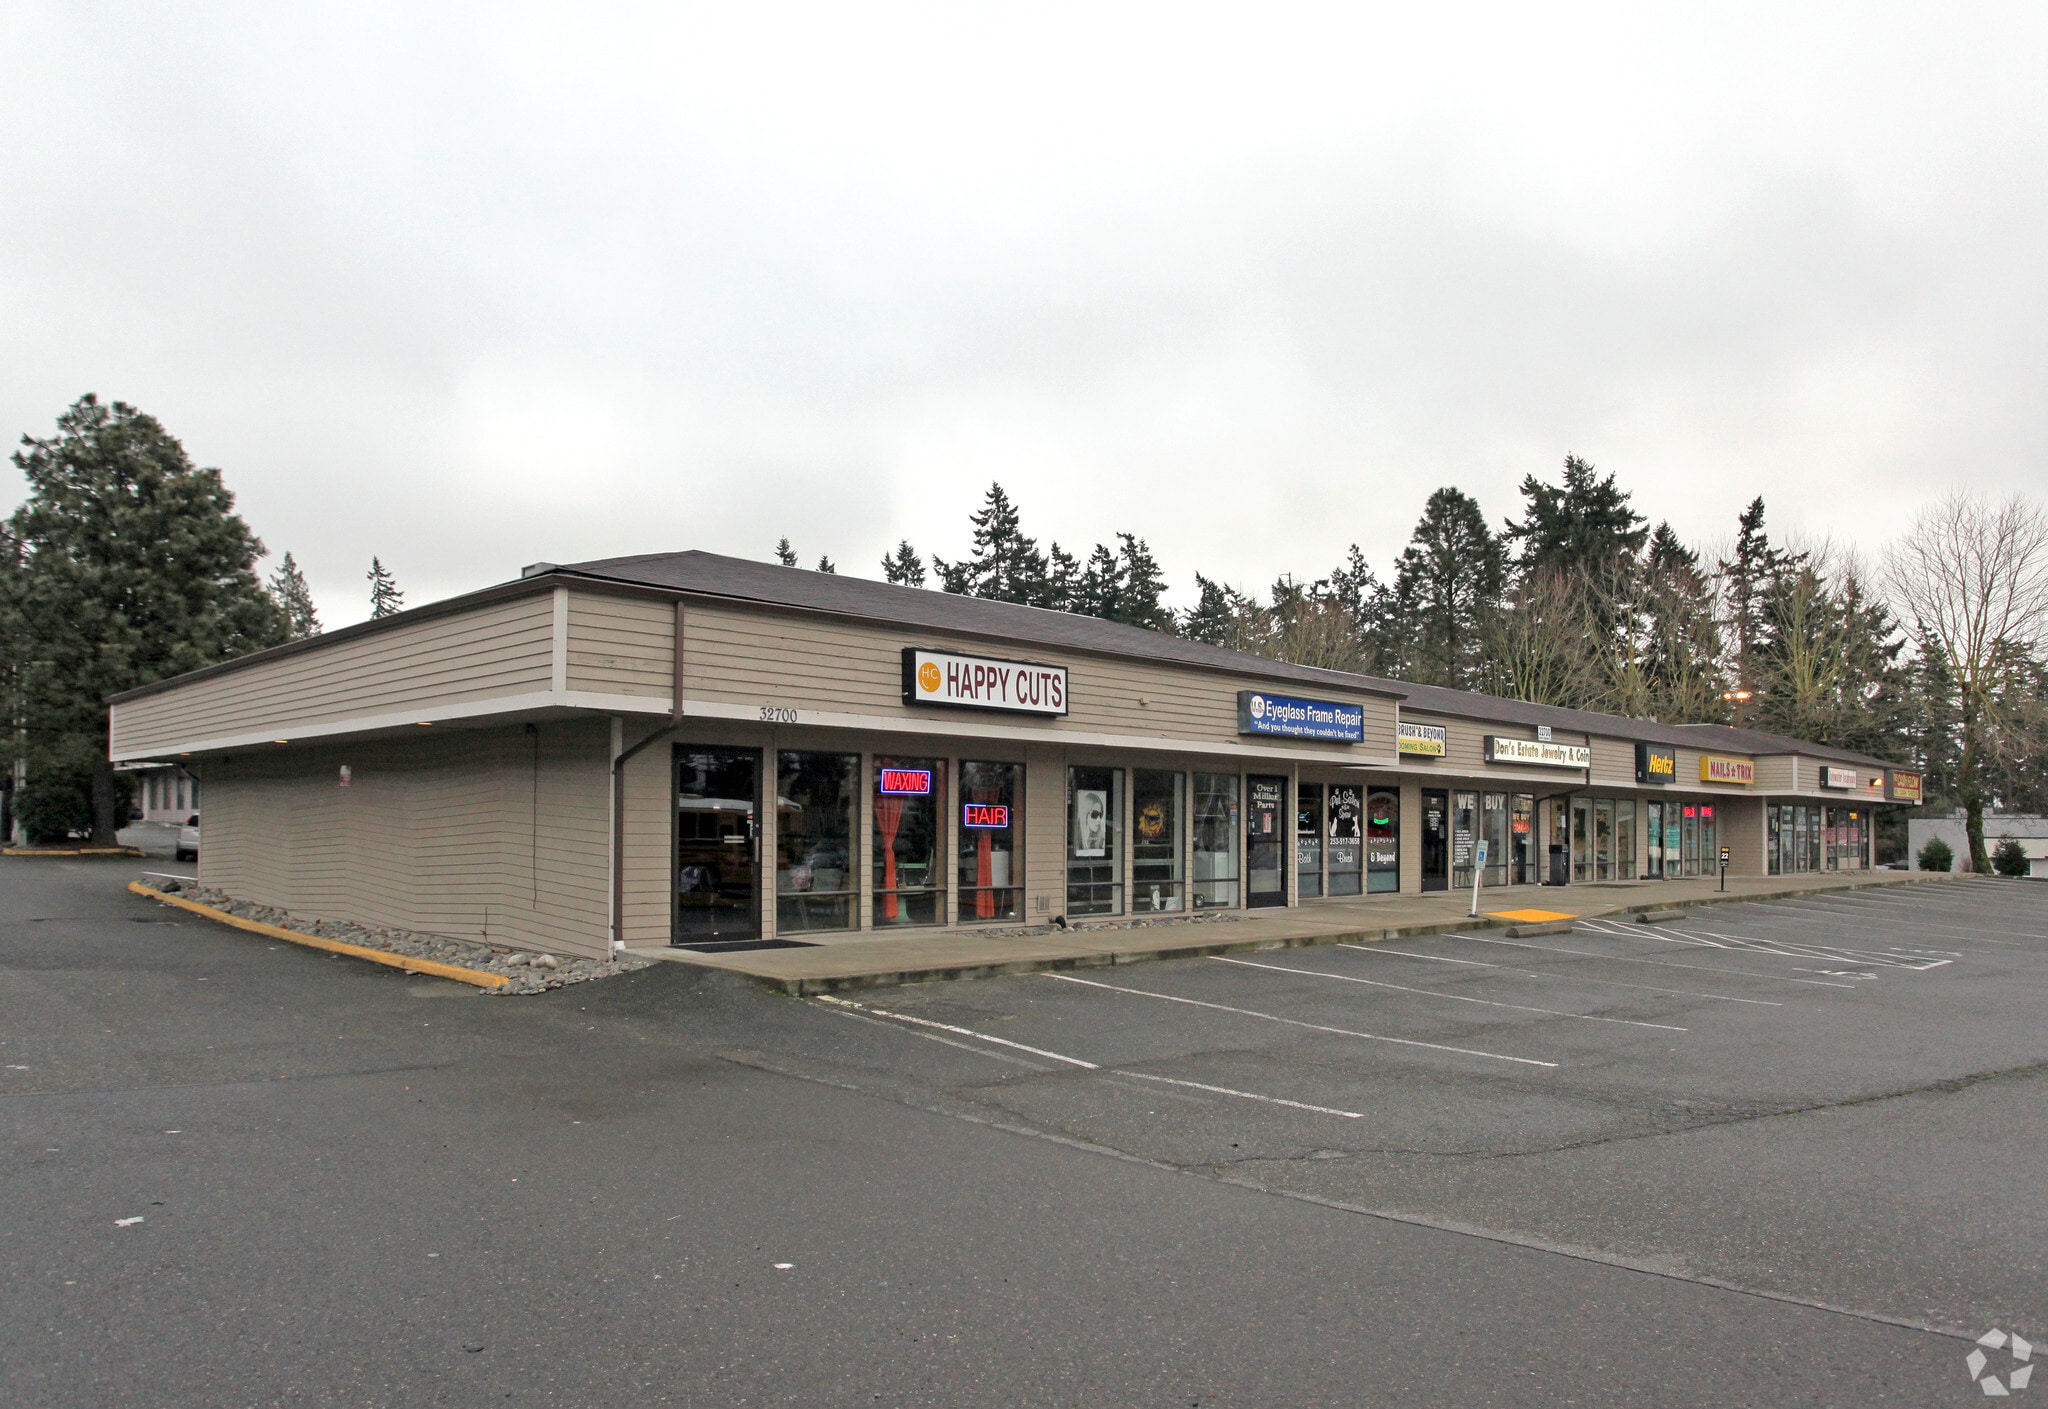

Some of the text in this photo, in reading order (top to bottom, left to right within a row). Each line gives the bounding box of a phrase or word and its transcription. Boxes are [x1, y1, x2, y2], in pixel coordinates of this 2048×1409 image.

[922, 667, 938, 680] HC
[947, 661, 1062, 708] HAPPY CUTS
[760, 707, 797, 723] 32700
[1266, 700, 1362, 728] Eyeglass Frame Repair
[1270, 725, 1281, 733] you
[1281, 725, 1303, 735] thought
[1303, 727, 1316, 736] they
[1417, 726, 1422, 737] &
[1495, 739, 1590, 764] Don's Estate Jewelry & Coin
[1648, 754, 1674, 775] Hertz
[1710, 761, 1752, 780] NAILS TRIX
[883, 771, 928, 791] WAXING
[1256, 783, 1274, 792] Over
[1257, 801, 1275, 809] Parts
[1457, 794, 1474, 810] WE
[1485, 795, 1504, 810] BUY
[966, 806, 1006, 824] HAIR
[1720, 852, 1729, 860] 22
